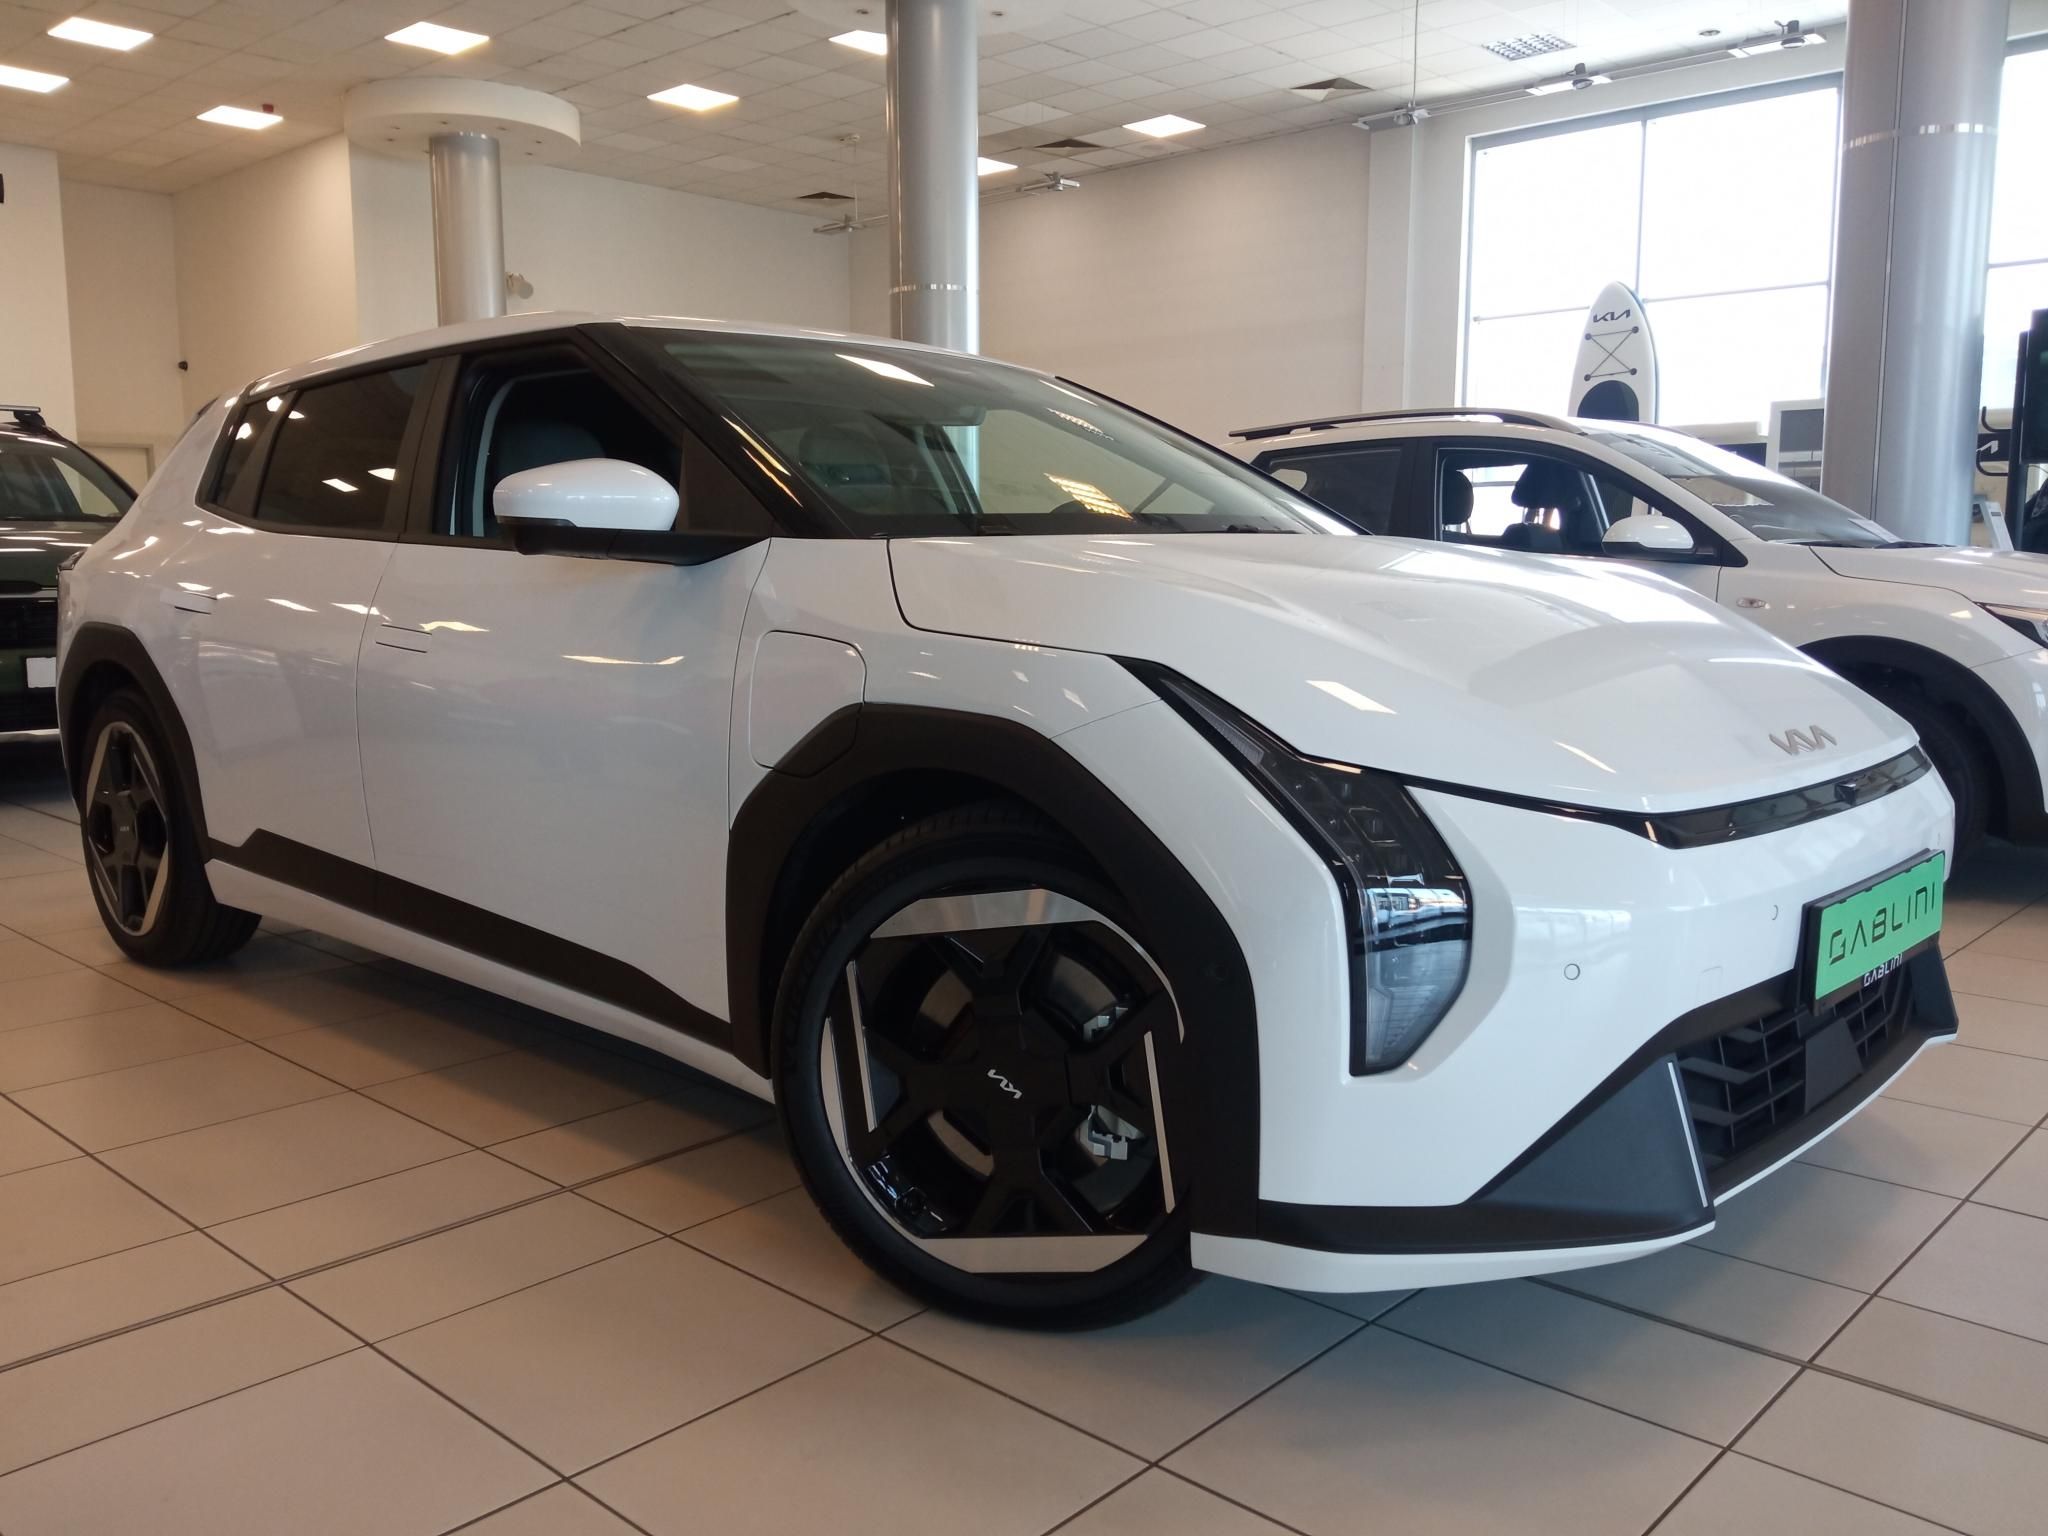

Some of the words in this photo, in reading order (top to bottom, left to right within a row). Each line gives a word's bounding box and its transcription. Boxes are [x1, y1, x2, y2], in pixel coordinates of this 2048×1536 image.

[1593, 309, 1631, 323] KIA
[1768, 725, 1837, 756] KIA
[1829, 882, 1935, 965] GABLINI
[1864, 953, 1902, 987] GABLINI
